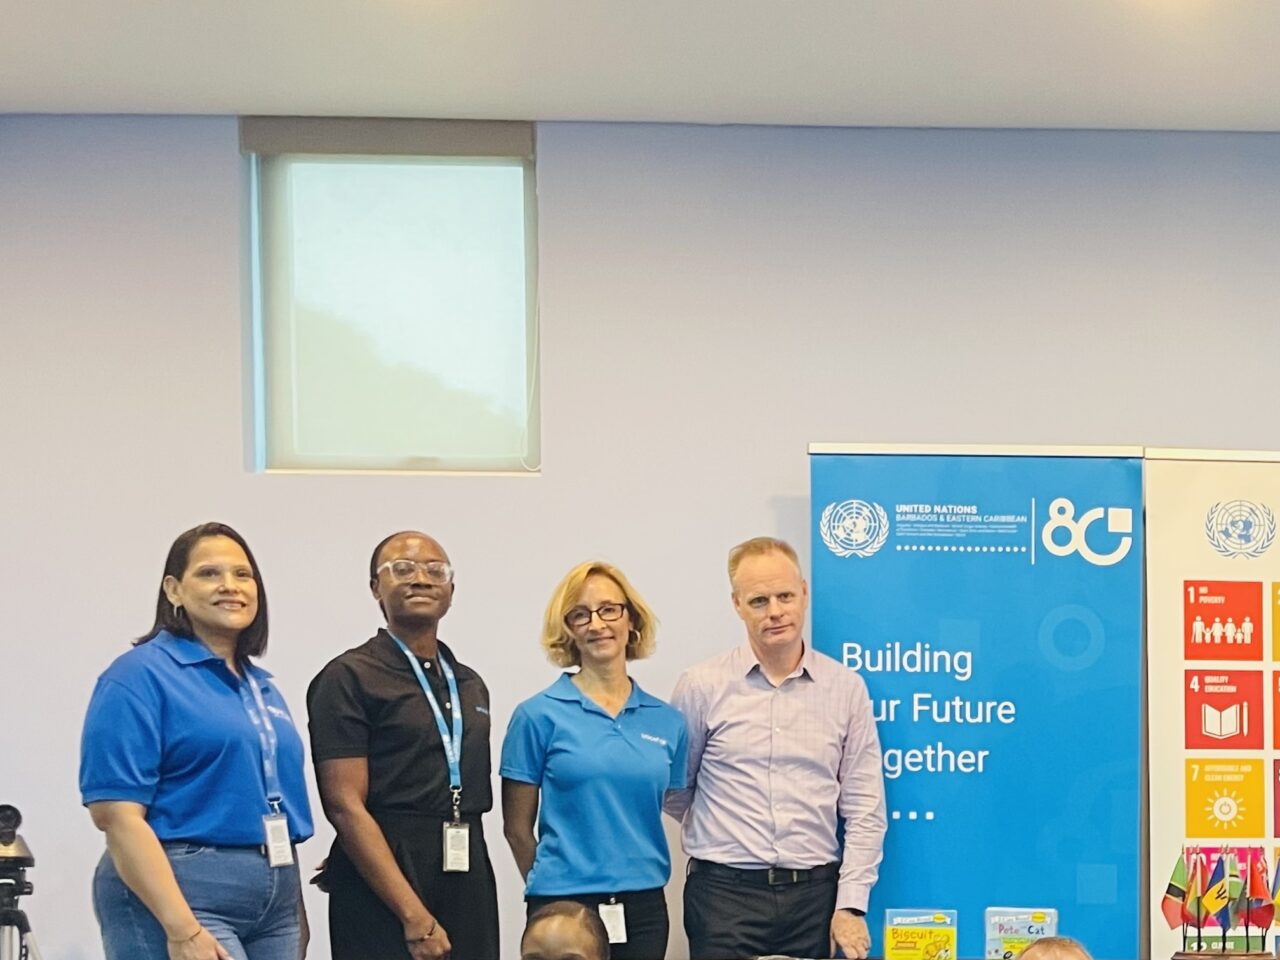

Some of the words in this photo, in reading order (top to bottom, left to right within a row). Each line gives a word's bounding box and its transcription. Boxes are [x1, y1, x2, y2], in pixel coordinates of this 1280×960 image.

[895, 504, 932, 513] UNITED
[934, 505, 978, 514] NATIONS
[895, 513, 938, 522] BARBADOS
[1187, 586, 1195, 605] 1
[842, 641, 972, 681] Building
[1190, 675, 1200, 693] 4
[869, 698, 901, 722] ur
[913, 693, 1016, 724] Future
[883, 742, 990, 779] gether
[1191, 764, 1200, 782] 7
[892, 928, 933, 940] Biscuit
[1028, 925, 1045, 935] Cat
